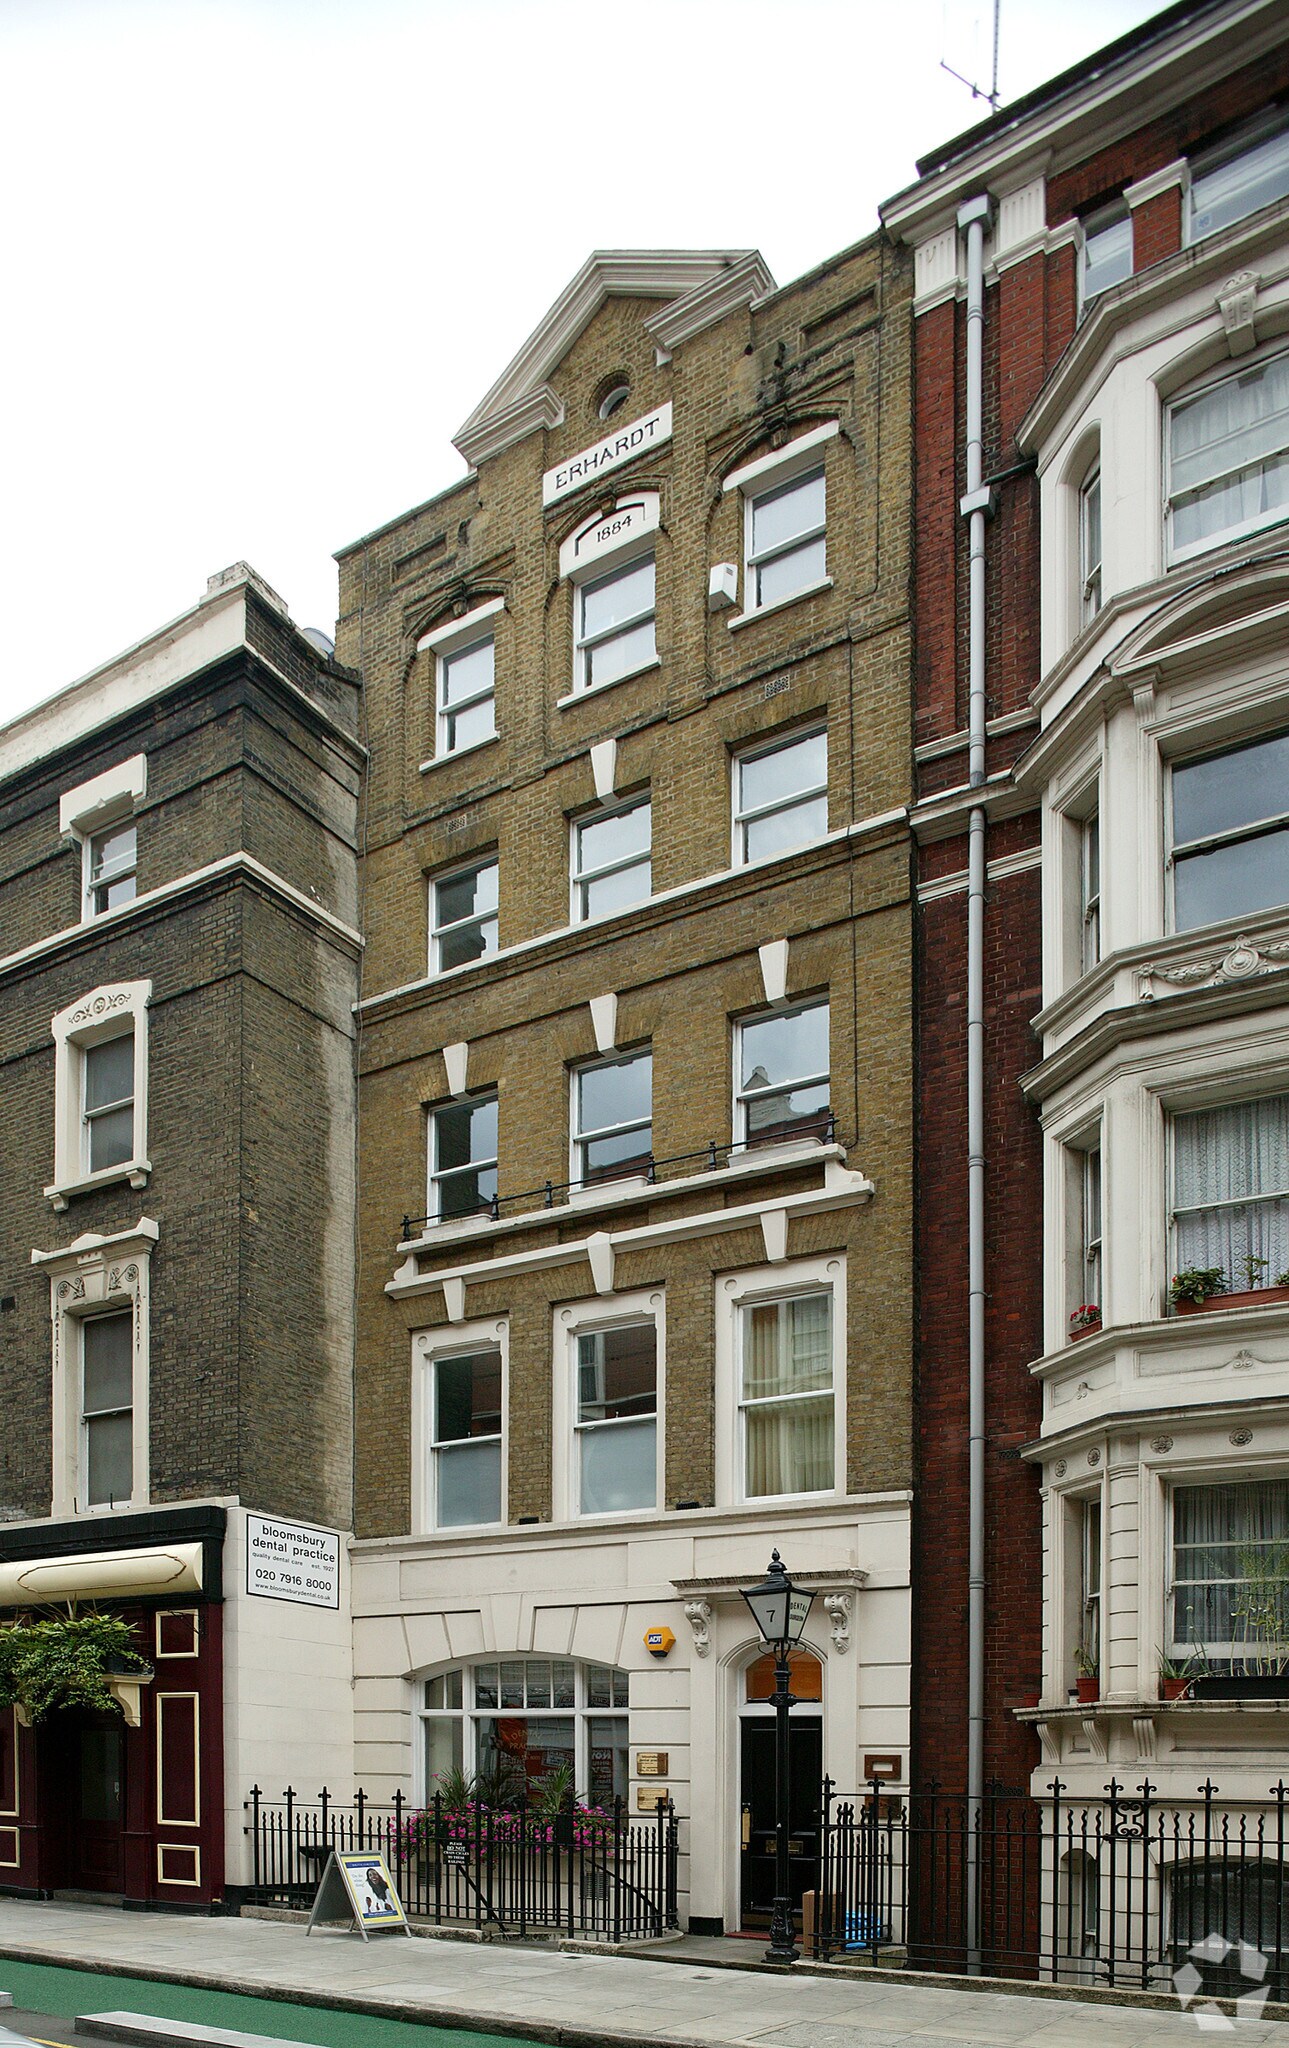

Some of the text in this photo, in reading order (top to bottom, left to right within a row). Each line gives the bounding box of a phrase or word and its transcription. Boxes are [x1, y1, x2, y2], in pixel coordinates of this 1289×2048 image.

[555, 417, 660, 490] ERHARDT
[597, 515, 632, 543] 1884
[262, 1524, 326, 1549] bloomsbury
[252, 1537, 335, 1563] dental practice
[252, 1551, 271, 1560] quality
[272, 1555, 290, 1563] dental
[255, 1568, 332, 1591] 020 7916 8000
[766, 1610, 776, 1623] 7
[790, 1601, 808, 1613] DENTAL
[648, 1635, 662, 1643] ADT
